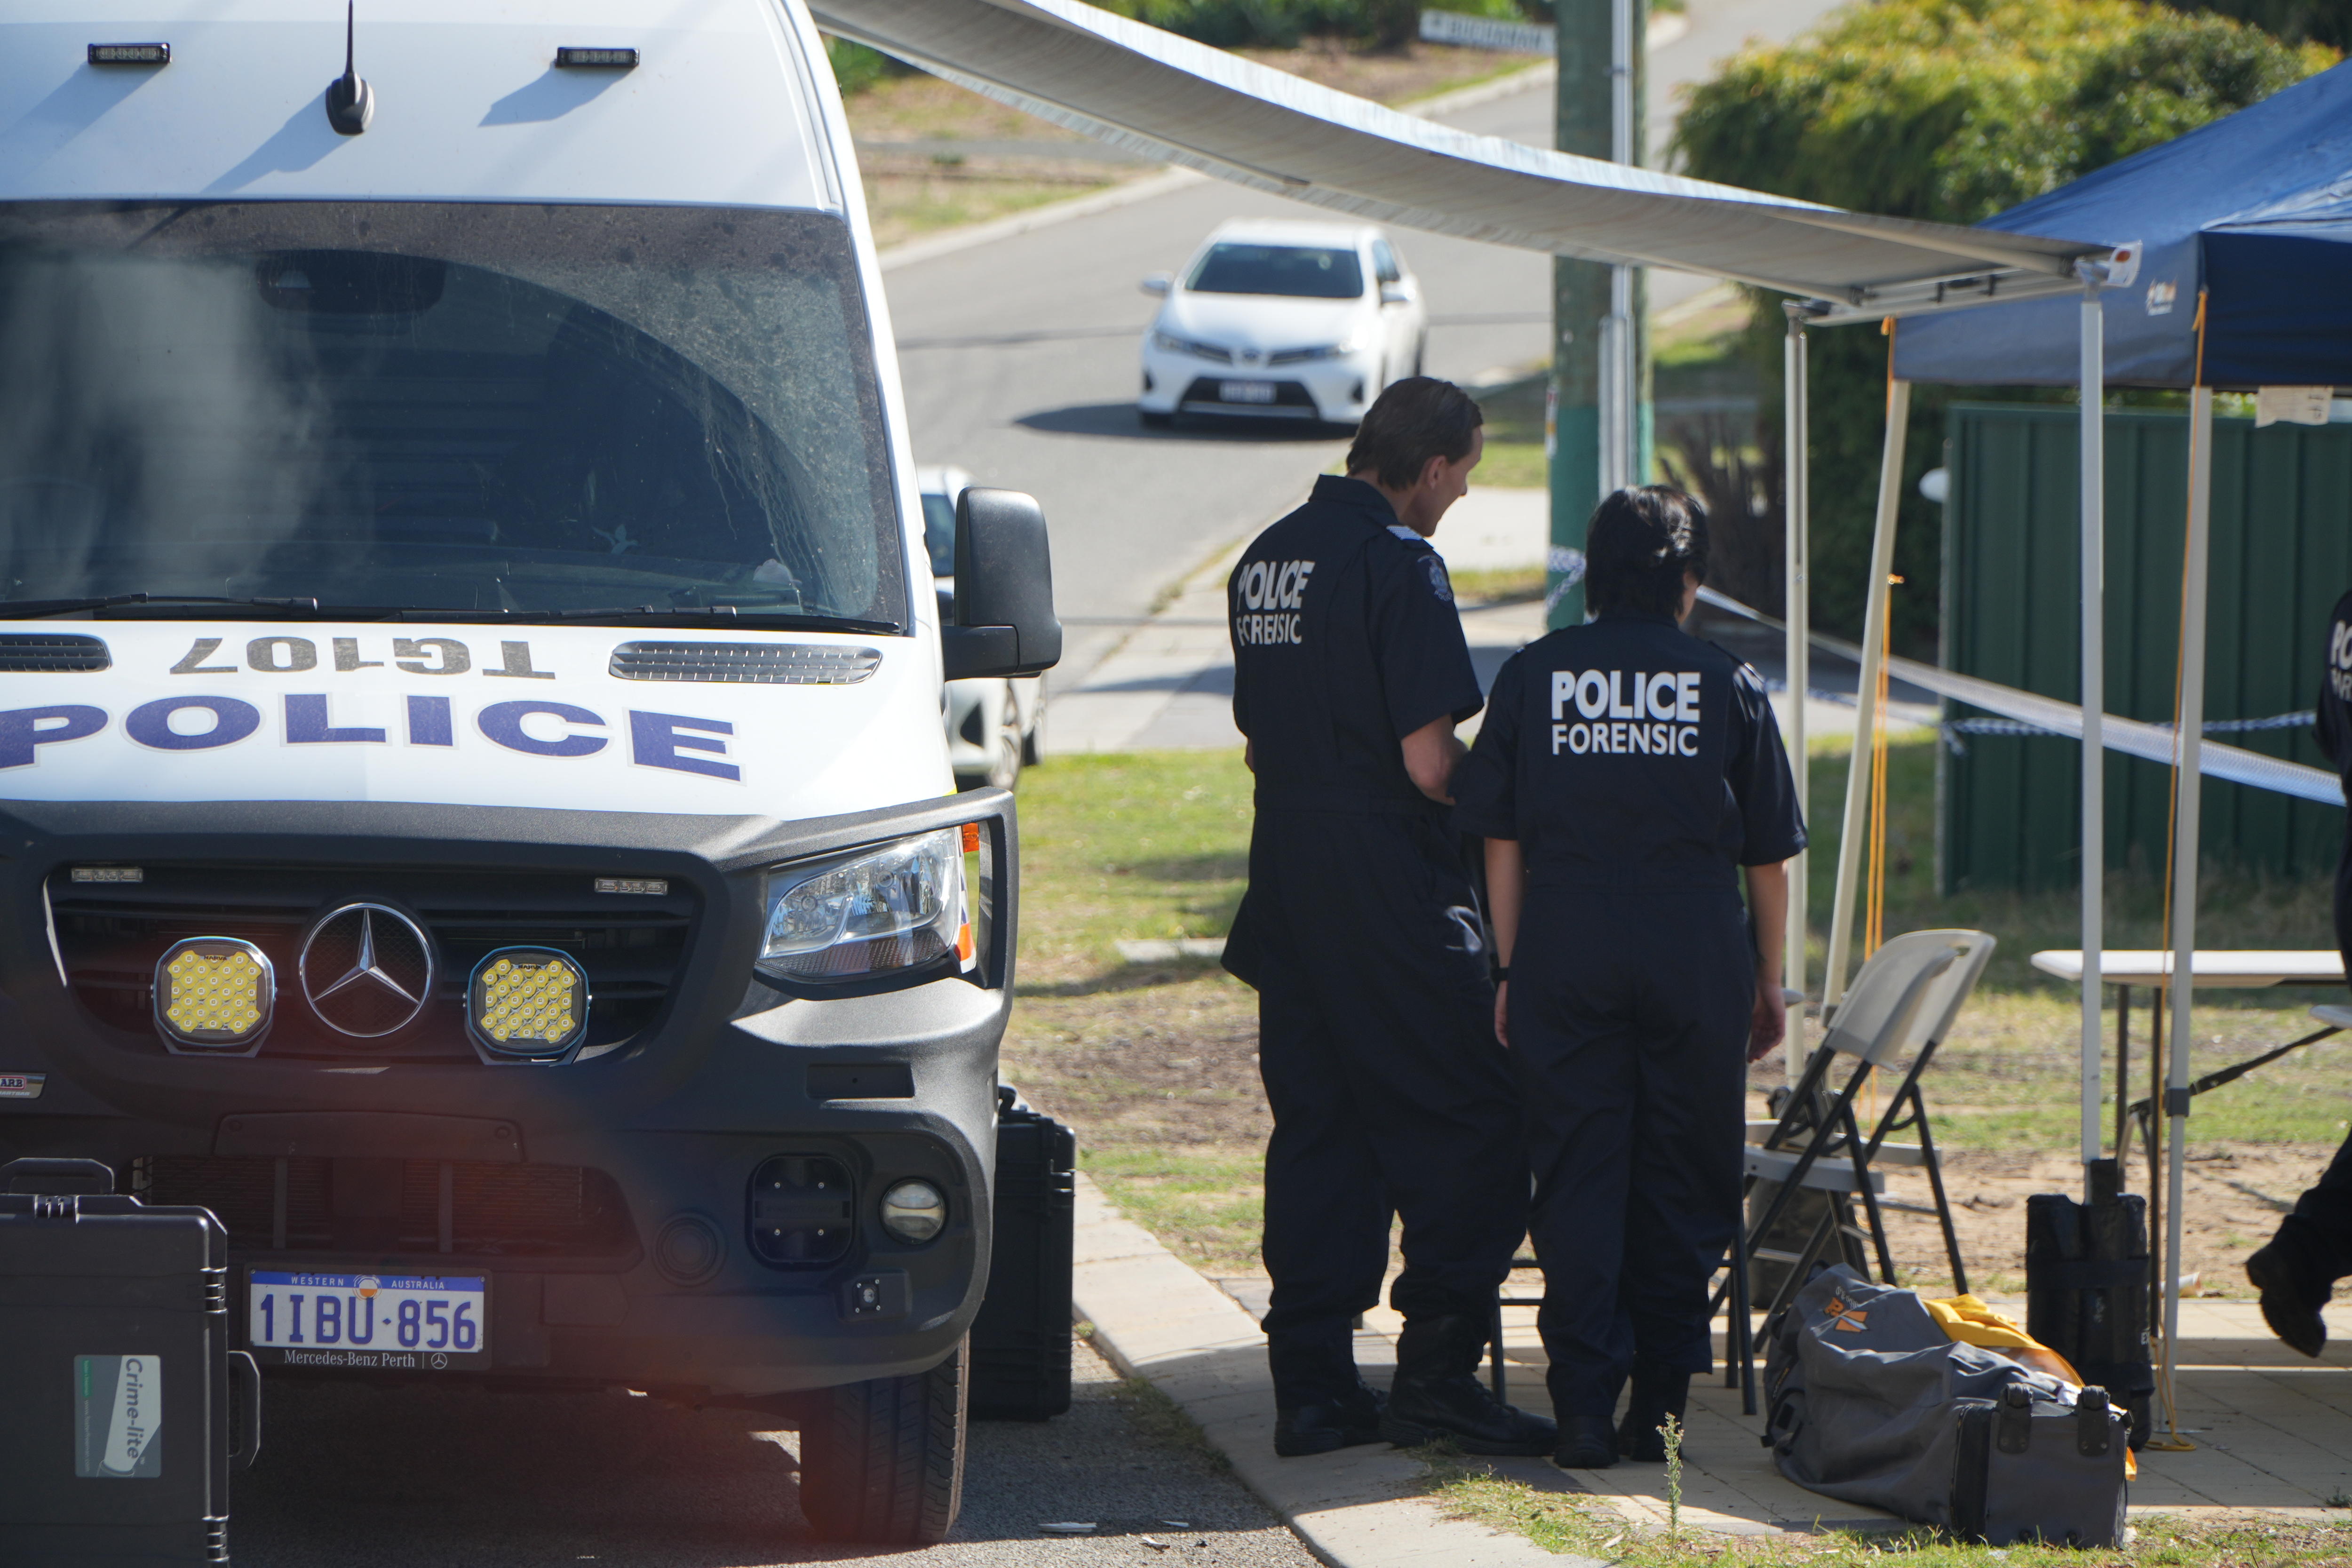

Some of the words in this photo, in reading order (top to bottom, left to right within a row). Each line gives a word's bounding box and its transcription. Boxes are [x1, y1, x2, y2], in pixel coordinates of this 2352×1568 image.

[170, 636, 556, 680] TG107
[1552, 669, 1700, 722] POLICE
[0, 692, 743, 783] POLICE
[1552, 723, 1699, 757] FORENSIC
[0, 1079, 23, 1087] ARB
[291, 1276, 344, 1287] WESTERN
[391, 1280, 445, 1290] AUSTRALIA
[284, 1350, 377, 1367] Mercedes-Benz
[381, 1353, 415, 1368] Perth
[126, 1358, 144, 1459] Crime-lite
